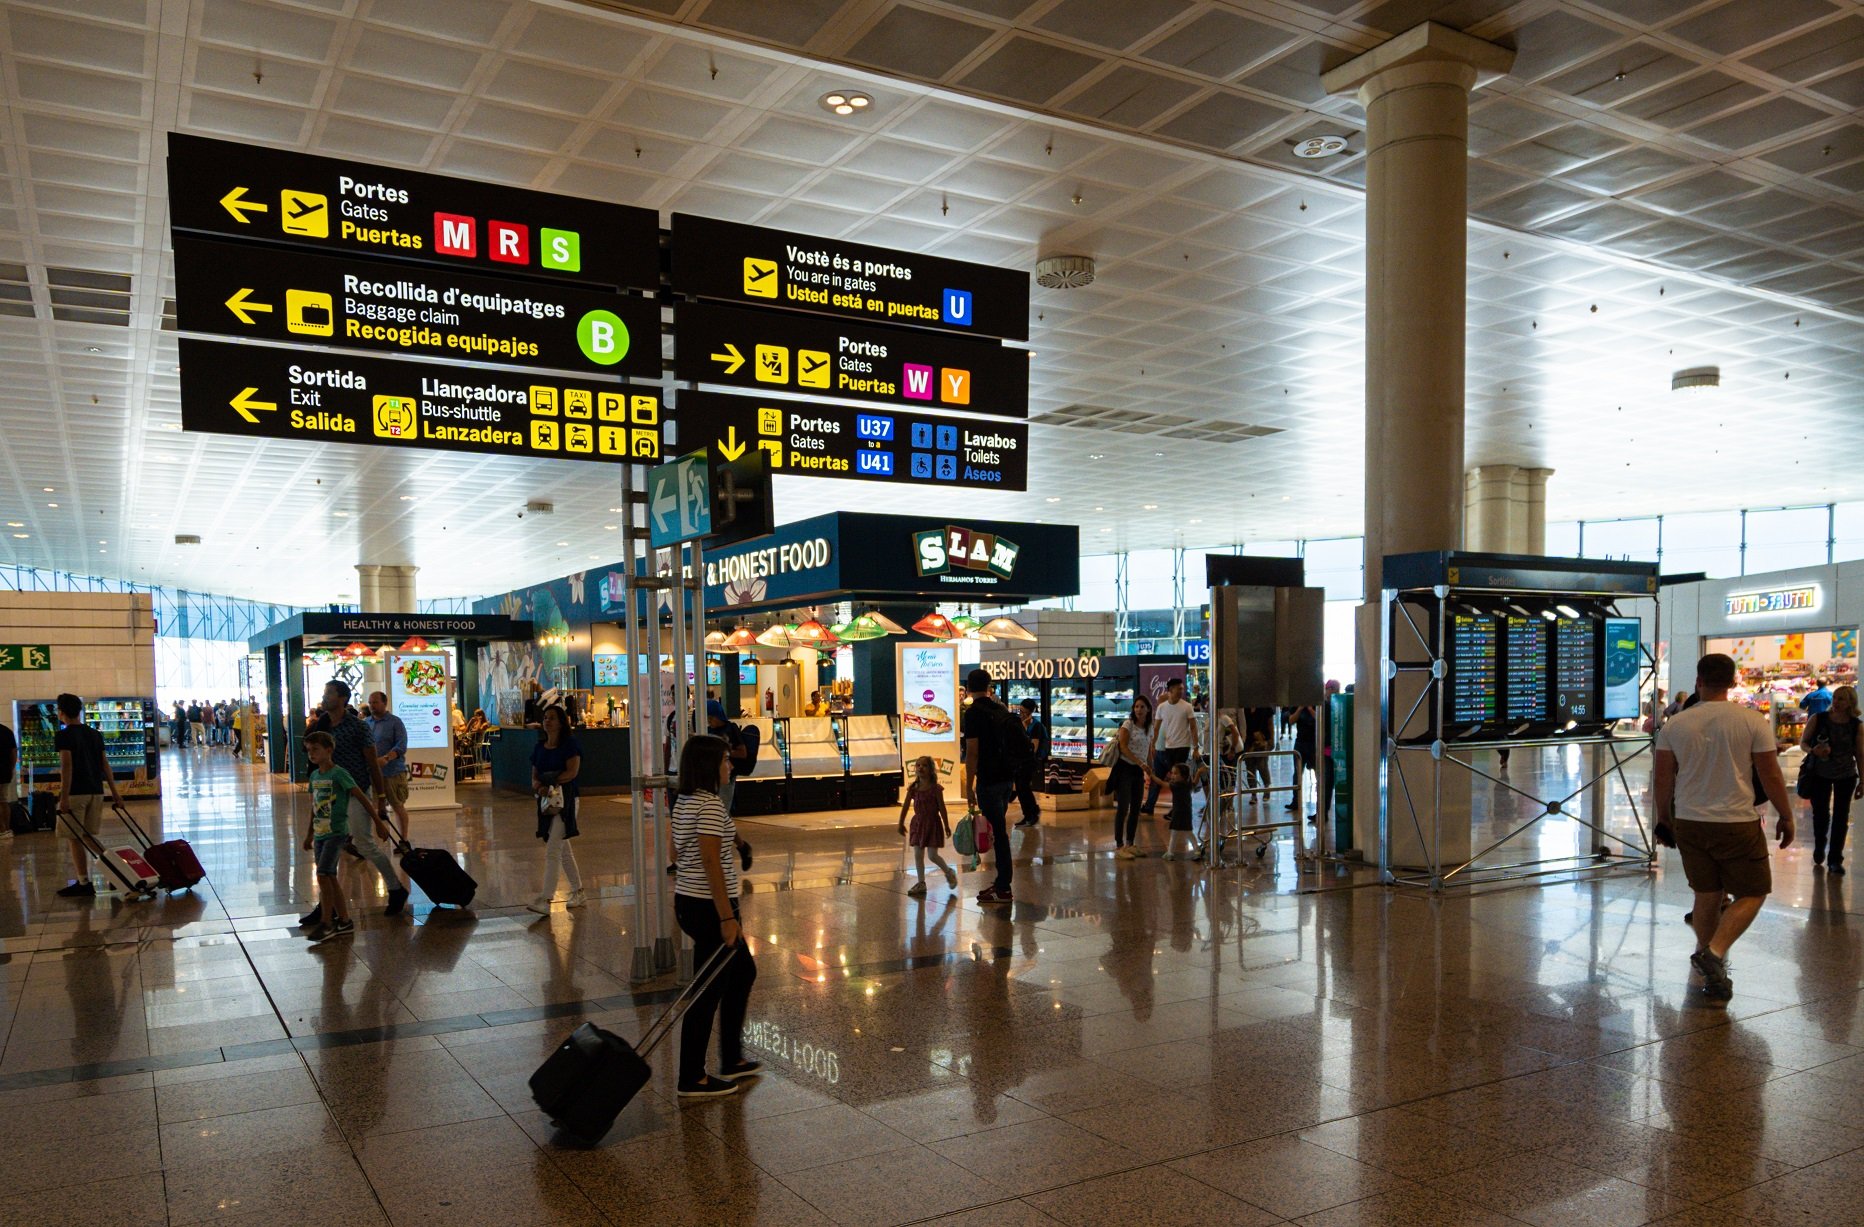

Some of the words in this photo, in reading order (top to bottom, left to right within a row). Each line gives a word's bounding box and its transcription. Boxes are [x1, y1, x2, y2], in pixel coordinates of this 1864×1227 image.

[339, 175, 409, 204] Portes
[340, 200, 389, 222] Gates
[341, 221, 423, 249] Puertas
[442, 220, 470, 250] M
[500, 229, 520, 257] R
[552, 236, 570, 263] S
[786, 245, 830, 267] Vostè
[832, 253, 850, 271] és
[852, 259, 863, 273] a
[865, 261, 912, 281] portes
[786, 265, 808, 282] You
[811, 272, 830, 285] are
[832, 273, 842, 286] in
[844, 276, 877, 292] gates
[344, 274, 438, 303] Recollida
[443, 287, 565, 319] d'equipatges
[787, 283, 829, 305] Usted
[832, 293, 863, 310] está
[867, 298, 884, 313] en
[888, 301, 940, 321] puertas
[950, 295, 965, 319] U
[345, 297, 417, 323] Baggage
[420, 308, 460, 326] claim
[346, 318, 442, 348] Recogida
[447, 333, 539, 358] equipajes
[592, 320, 615, 354] B
[839, 336, 888, 358] Portes
[839, 356, 873, 373] Gates
[288, 364, 367, 390] Sortida
[838, 373, 896, 395] Puertas
[907, 369, 929, 393] W
[948, 375, 964, 397] Y
[290, 388, 322, 407] Exit
[421, 377, 528, 405] Llançadora
[570, 391, 587, 399] TAXI
[421, 400, 502, 422] Bus-shuttle
[605, 398, 619, 417] P
[290, 409, 356, 433] Salida
[391, 427, 401, 435] T2
[790, 414, 840, 434] Portes
[860, 418, 891, 437] U37
[423, 420, 523, 446] Lanzadera
[636, 430, 654, 438] METRO
[790, 433, 825, 450] Gates
[868, 440, 875, 448] to
[964, 430, 1017, 450] Lavabos
[790, 451, 849, 471] Puertas
[861, 454, 891, 472] U41
[964, 447, 1001, 465] Toilets
[964, 465, 1002, 482] Aseos
[707, 562, 717, 586] &
[719, 547, 778, 584] HONEST
[780, 537, 829, 573] FOOD
[919, 531, 1016, 572] SLAM
[600, 576, 623, 606] SLA
[343, 620, 392, 630] HEALTHY
[393, 621, 400, 630] &
[403, 620, 445, 630] HONEST
[447, 620, 476, 630] FOOD
[980, 660, 1016, 680] FRESH
[1018, 659, 1054, 679] FOOD
[1056, 657, 1075, 678] TO
[1078, 656, 1100, 678] GO
